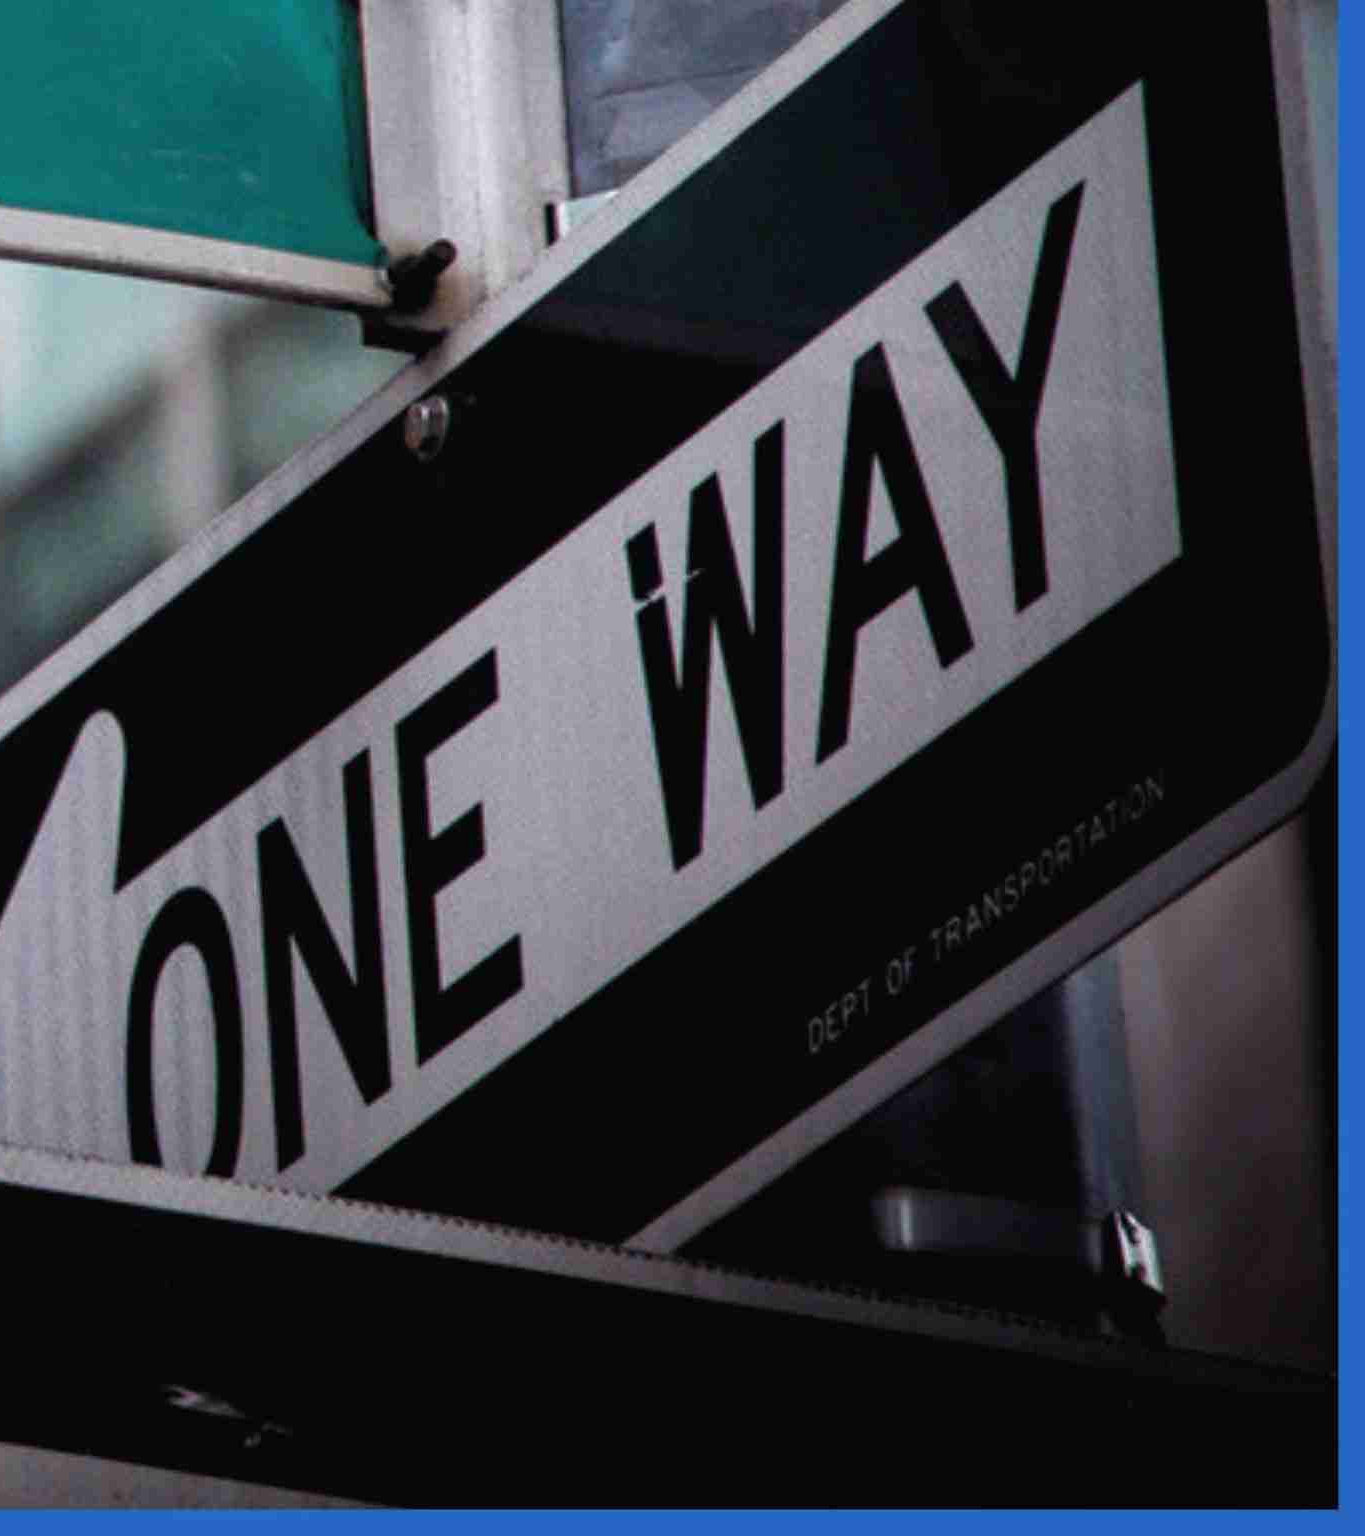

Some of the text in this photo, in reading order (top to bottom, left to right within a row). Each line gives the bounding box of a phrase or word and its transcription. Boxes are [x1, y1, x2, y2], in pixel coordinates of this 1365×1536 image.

[125, 178, 1088, 1180] ONE WAY
[807, 768, 1167, 1056] DEPT OF TRANSPORTATION
